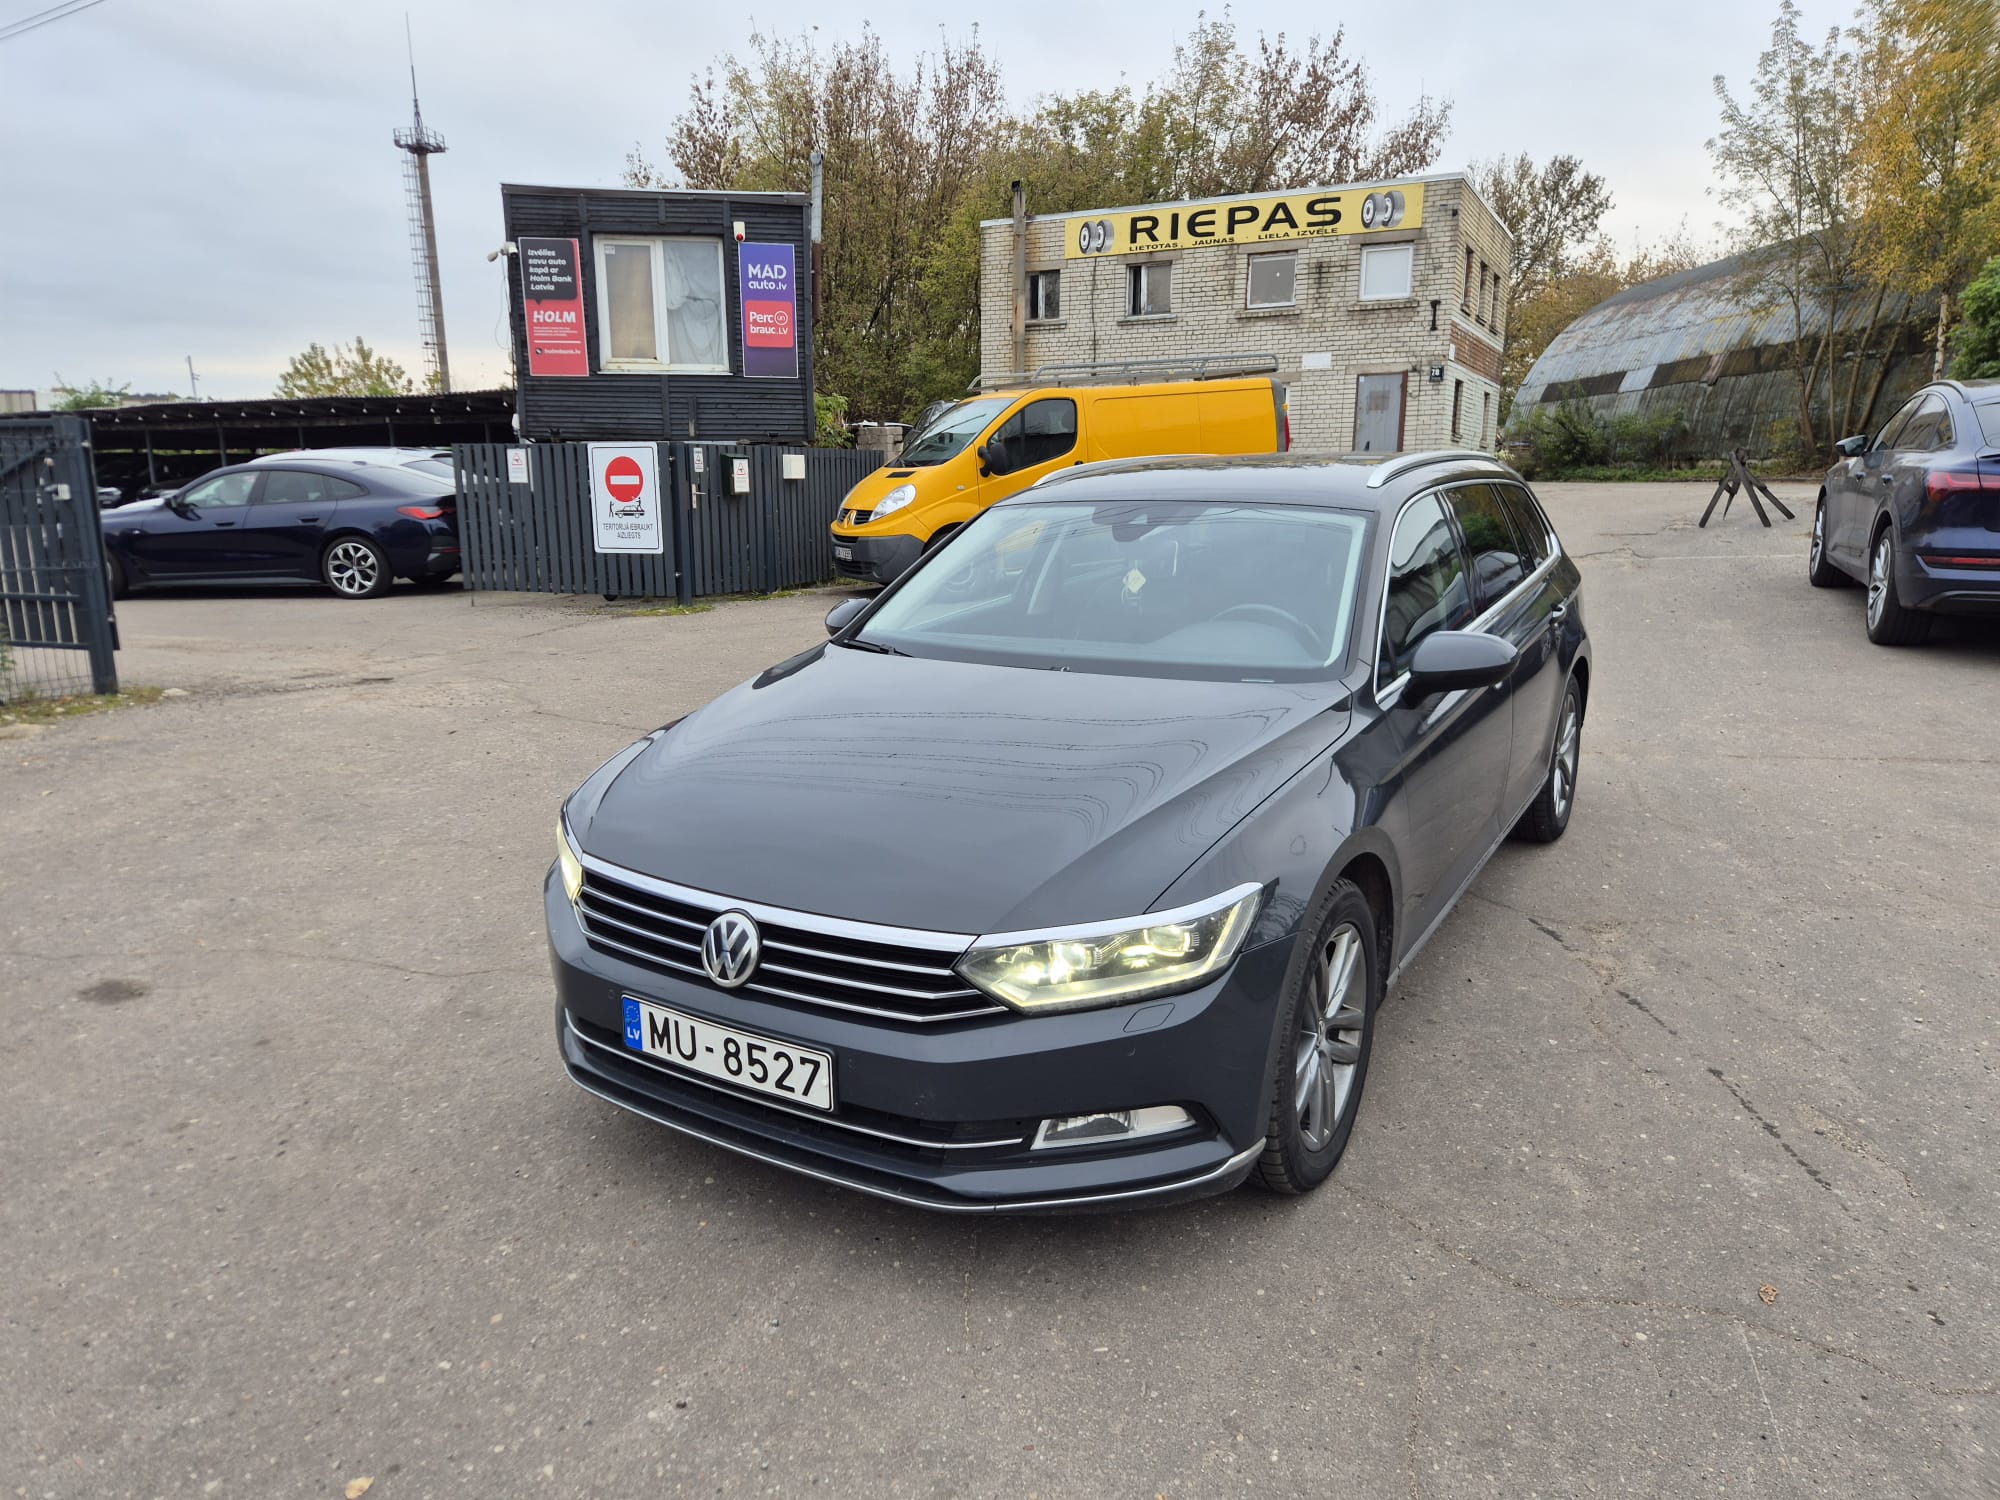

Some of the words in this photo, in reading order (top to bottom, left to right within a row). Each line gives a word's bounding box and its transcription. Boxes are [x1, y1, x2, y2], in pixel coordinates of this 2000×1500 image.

[1130, 197, 1342, 244] RIEPAS
[1192, 237, 1235, 247] JAUNAS
[1258, 231, 1290, 240] LIELA
[530, 274, 550, 282] Holm
[748, 263, 787, 279] MAD
[533, 310, 576, 323] HOLM
[749, 311, 774, 323] Perc
[627, 1026, 640, 1041] LV
[649, 1011, 821, 1097] MU-8527
